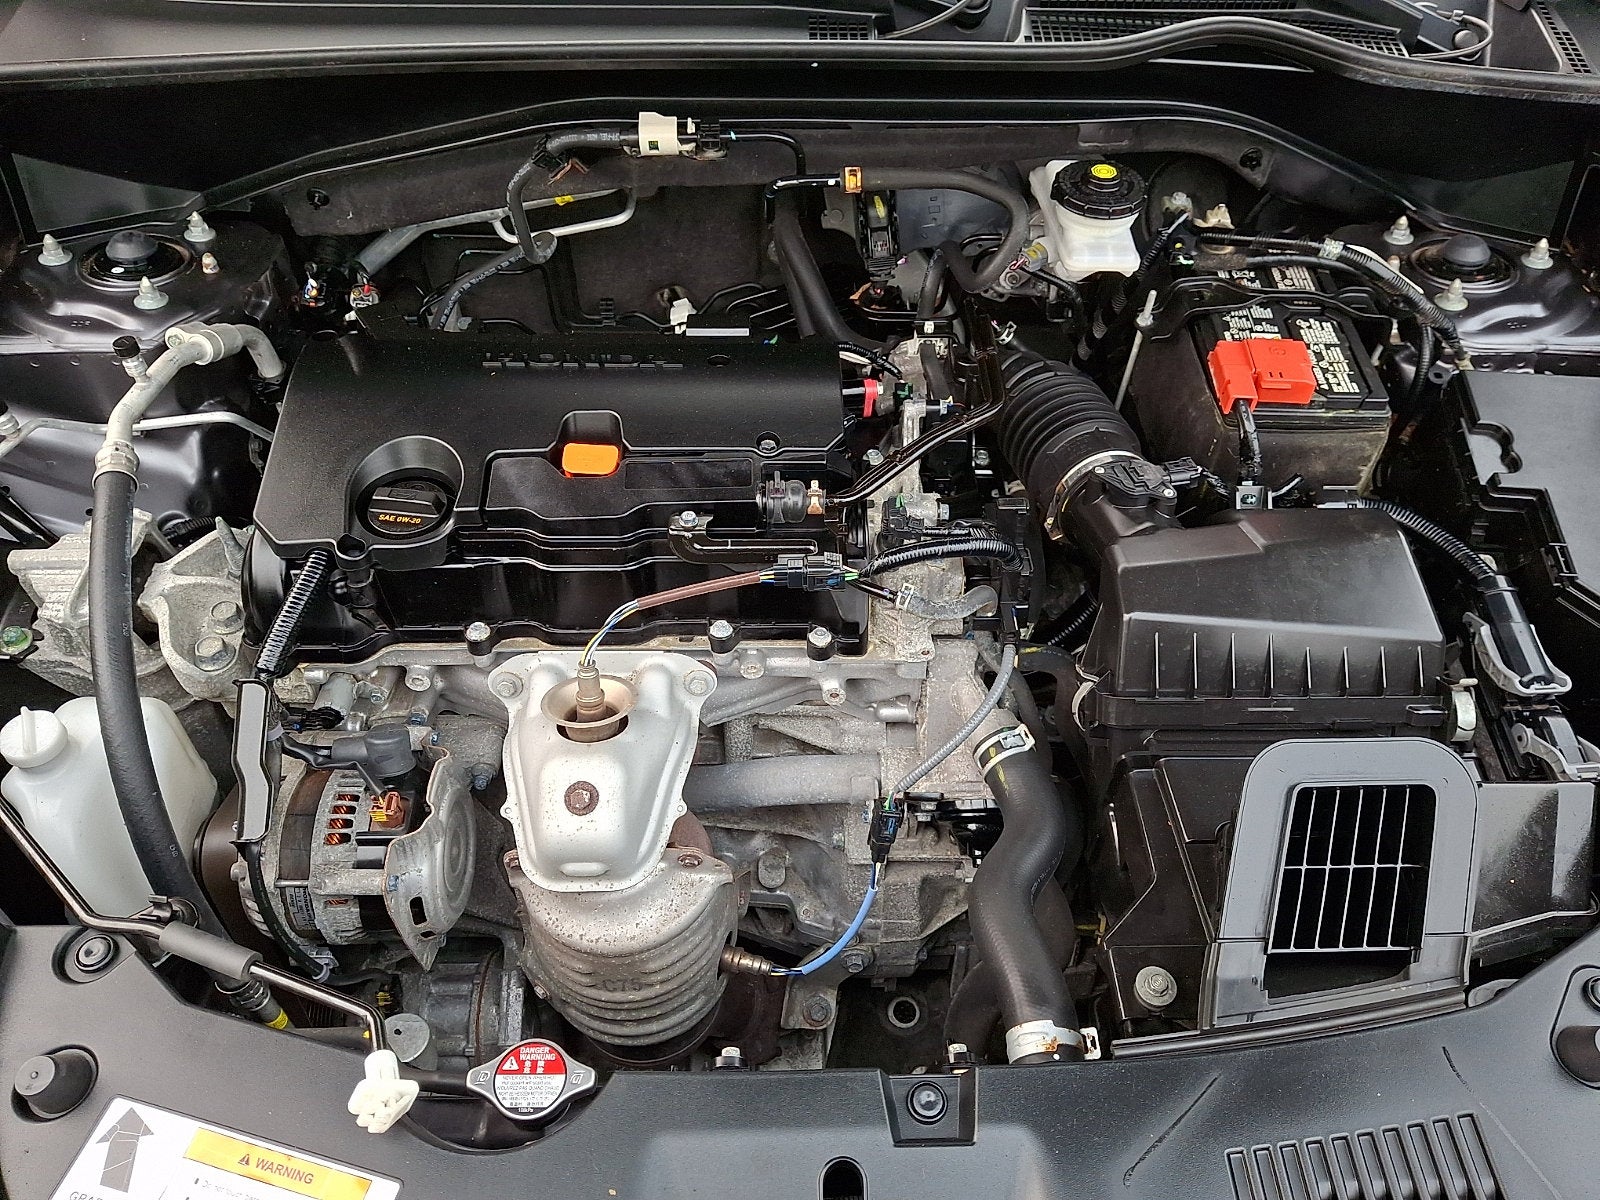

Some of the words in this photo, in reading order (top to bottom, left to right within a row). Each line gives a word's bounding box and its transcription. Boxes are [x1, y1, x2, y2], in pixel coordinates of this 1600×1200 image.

[378, 514, 396, 523] SAE
[396, 516, 421, 524] 0W-20
[255, 1157, 315, 1186] WARNING
